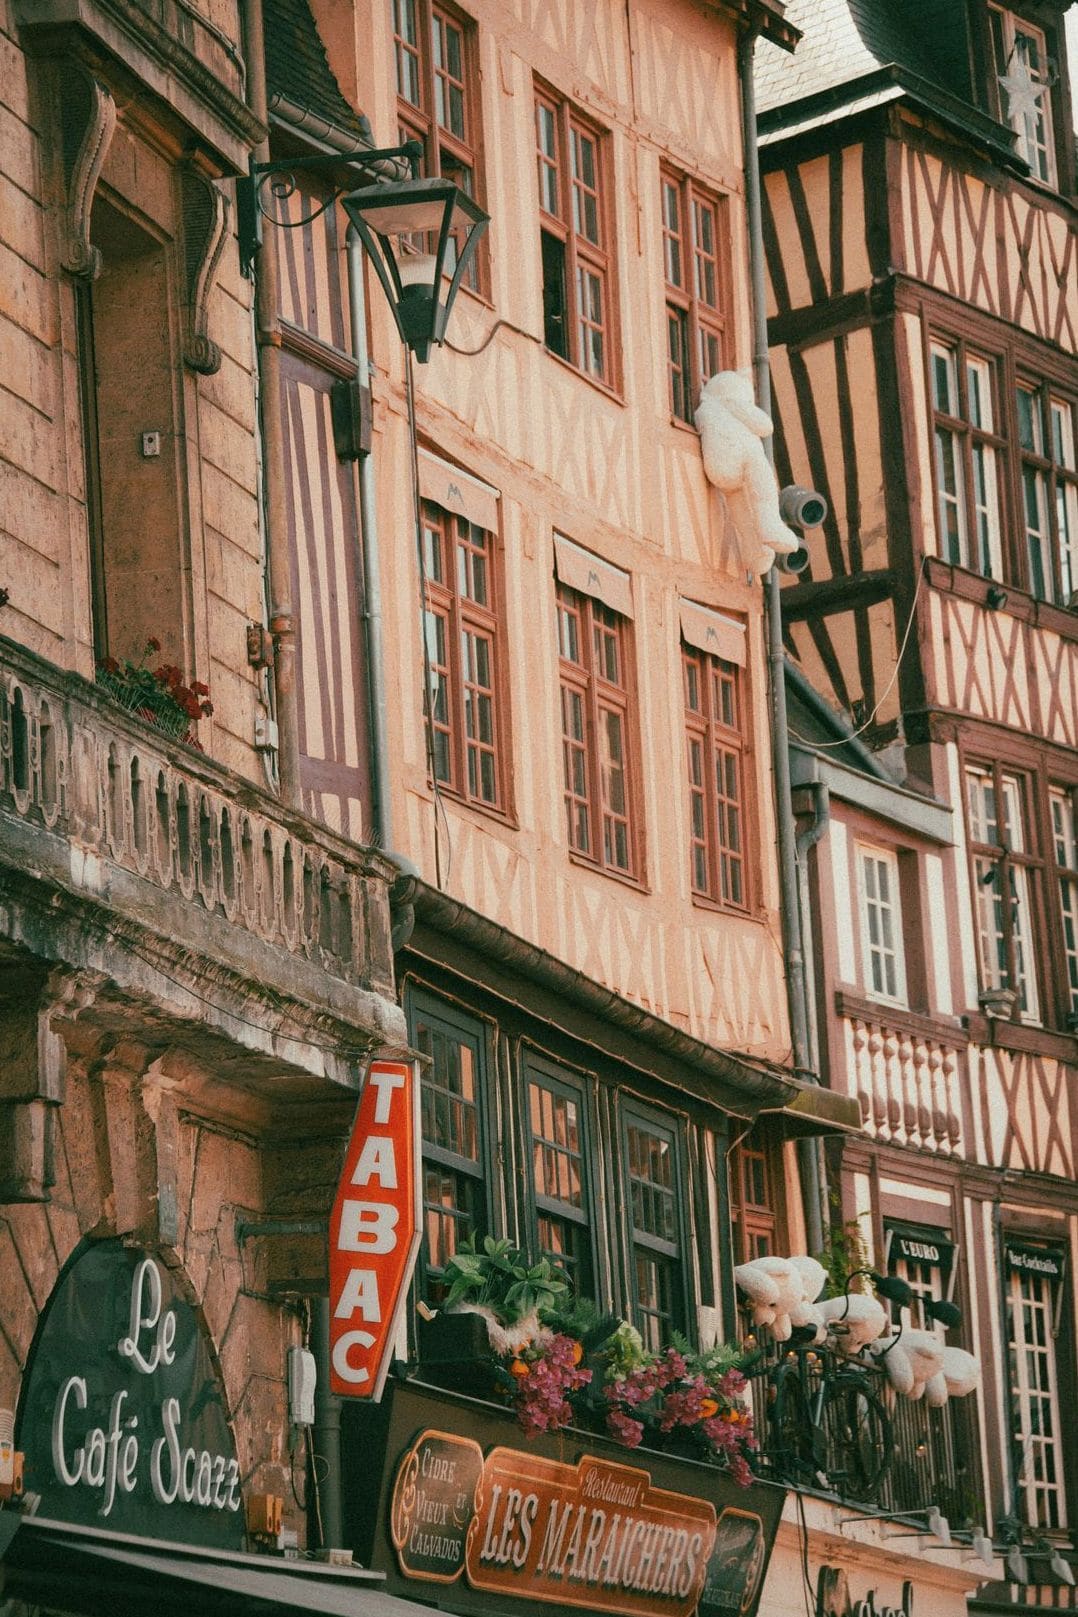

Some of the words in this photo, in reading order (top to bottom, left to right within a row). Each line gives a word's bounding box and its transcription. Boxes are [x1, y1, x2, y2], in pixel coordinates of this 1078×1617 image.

[331, 1072, 405, 1384] TABAC
[900, 1239, 940, 1261] L'EURO
[117, 1258, 176, 1374] Le
[52, 1375, 138, 1517] Café
[151, 1397, 241, 1512] Scazz
[422, 1447, 456, 1483] CIDRE
[416, 1489, 449, 1525] VIEUX
[582, 1465, 642, 1508] Restaurant
[409, 1521, 462, 1562] CALVADOS
[480, 1483, 540, 1568] LES
[537, 1498, 702, 1598] MARAICHERS
